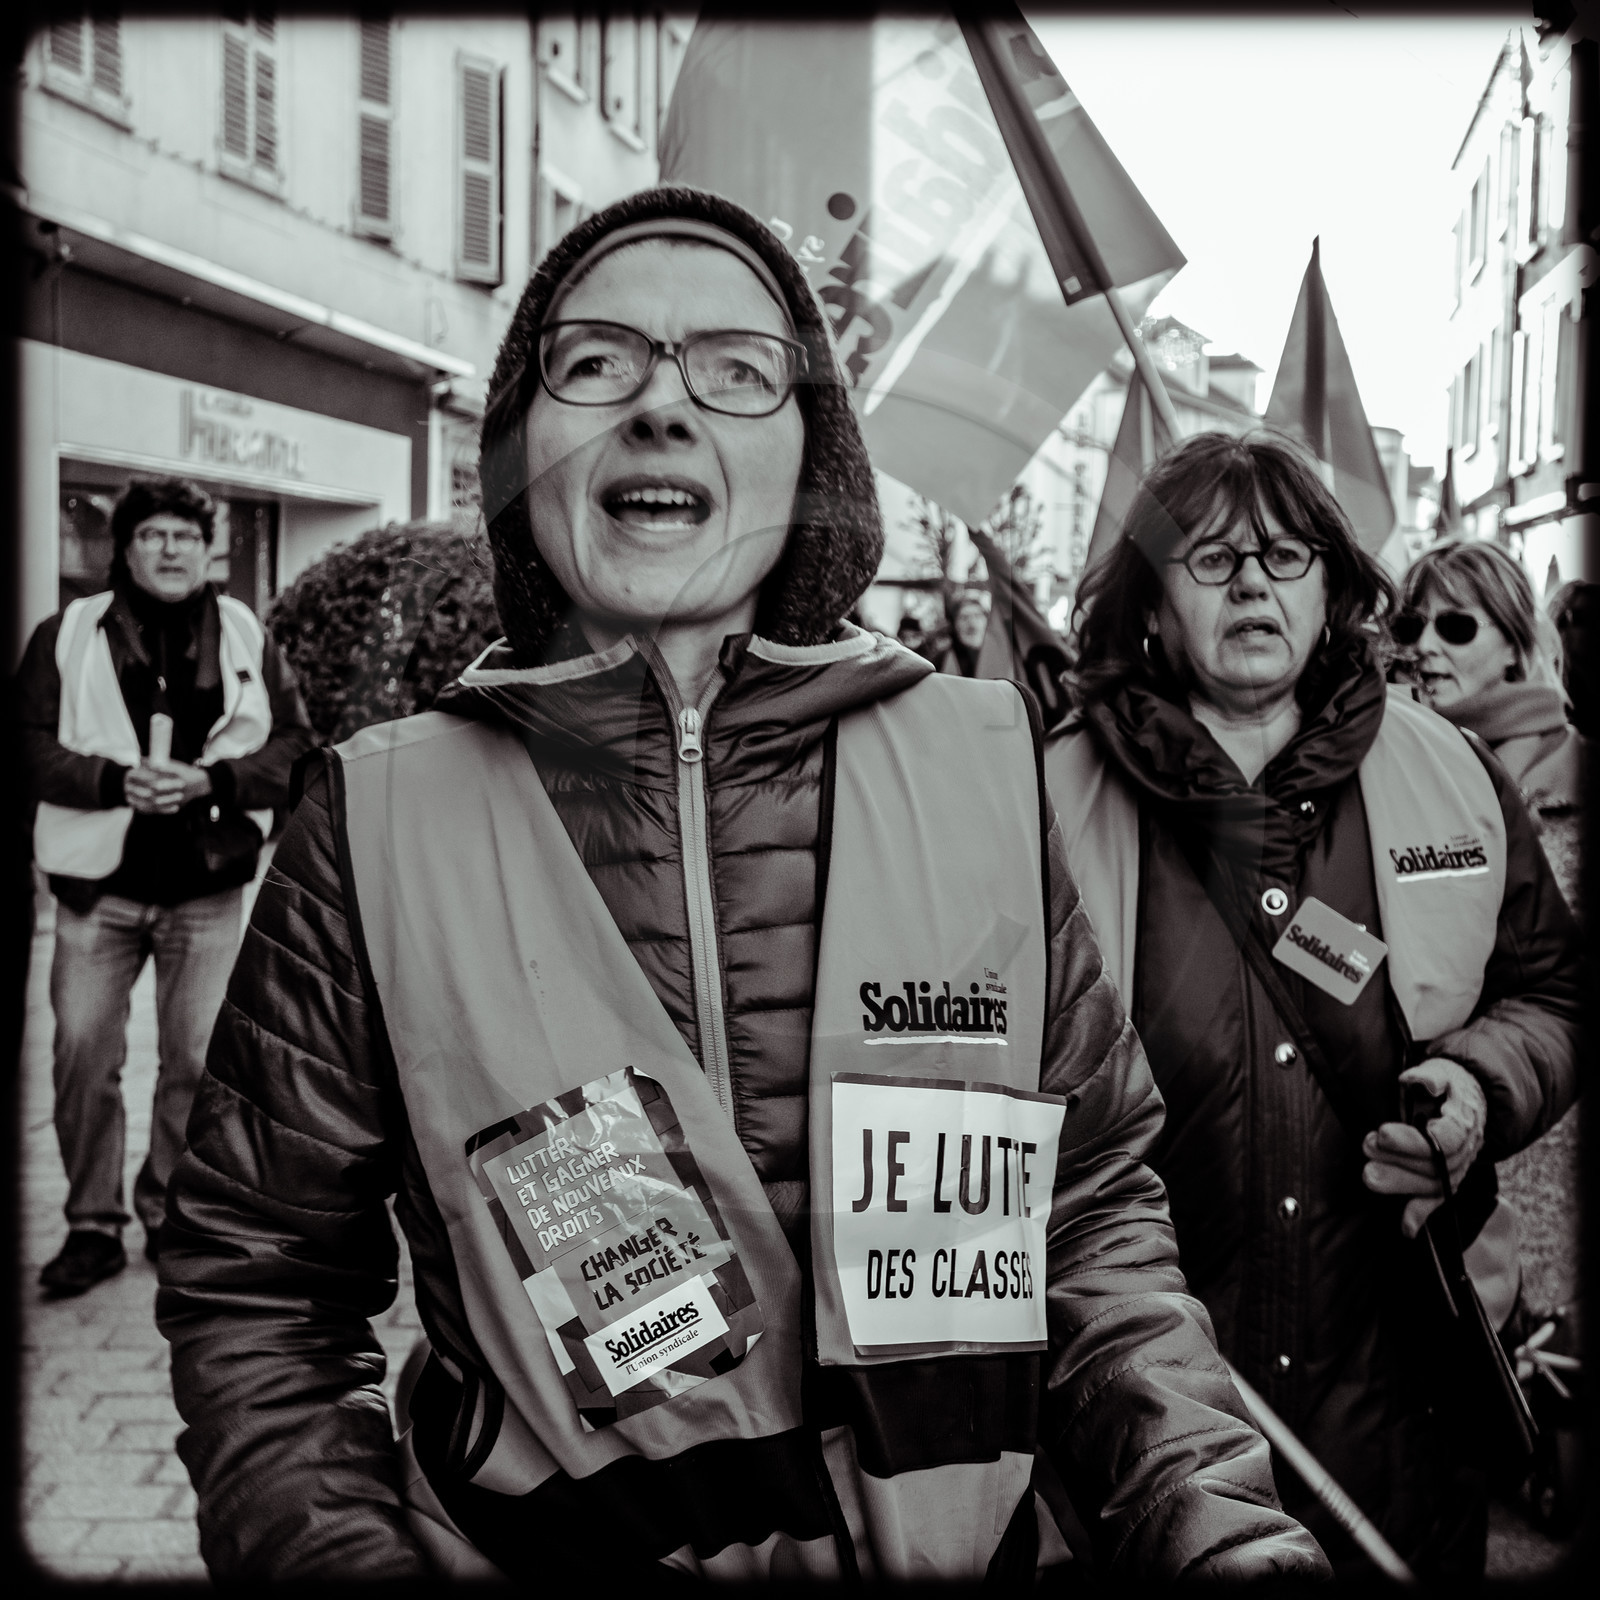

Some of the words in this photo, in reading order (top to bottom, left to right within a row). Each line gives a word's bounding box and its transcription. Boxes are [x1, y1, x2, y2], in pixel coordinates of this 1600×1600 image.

[1389, 844, 1488, 874] Solidaires
[1286, 924, 1364, 984] Solidaires
[860, 981, 1007, 1035] Solidaires
[506, 1137, 574, 1185] LUTTER
[516, 1181, 537, 1207] ET
[541, 1141, 620, 1193] GAGNER
[852, 1128, 910, 1213] JE
[526, 1205, 551, 1230] DE
[551, 1154, 647, 1217] NOUVEAUX
[580, 1217, 678, 1281] CHANGER
[867, 1248, 916, 1299] DES
[932, 1248, 1033, 1299] CLASSES
[593, 1281, 624, 1311] LA
[605, 1301, 699, 1363] Solidaires
[625, 1352, 658, 1376] l'Union
[659, 1328, 700, 1357] syndicale
